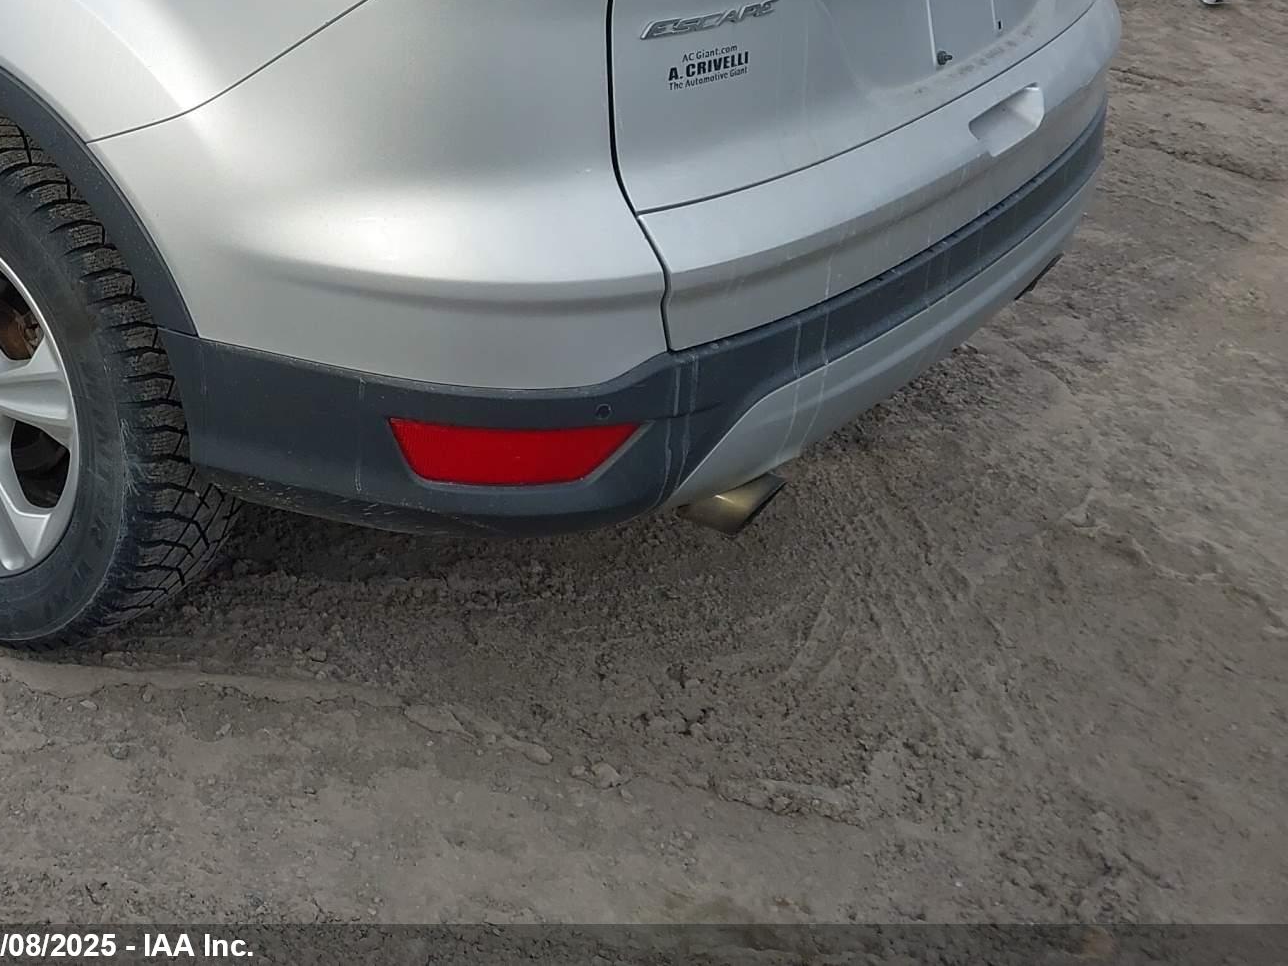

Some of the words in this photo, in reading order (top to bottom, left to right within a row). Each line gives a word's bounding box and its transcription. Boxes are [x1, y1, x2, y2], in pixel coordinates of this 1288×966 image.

[696, 44, 738, 60] Giant.com
[668, 67, 684, 81] A.
[686, 51, 749, 78] CRIVELLI
[669, 80, 683, 91] The
[685, 71, 728, 88] Automotive
[730, 66, 748, 78] Giant
